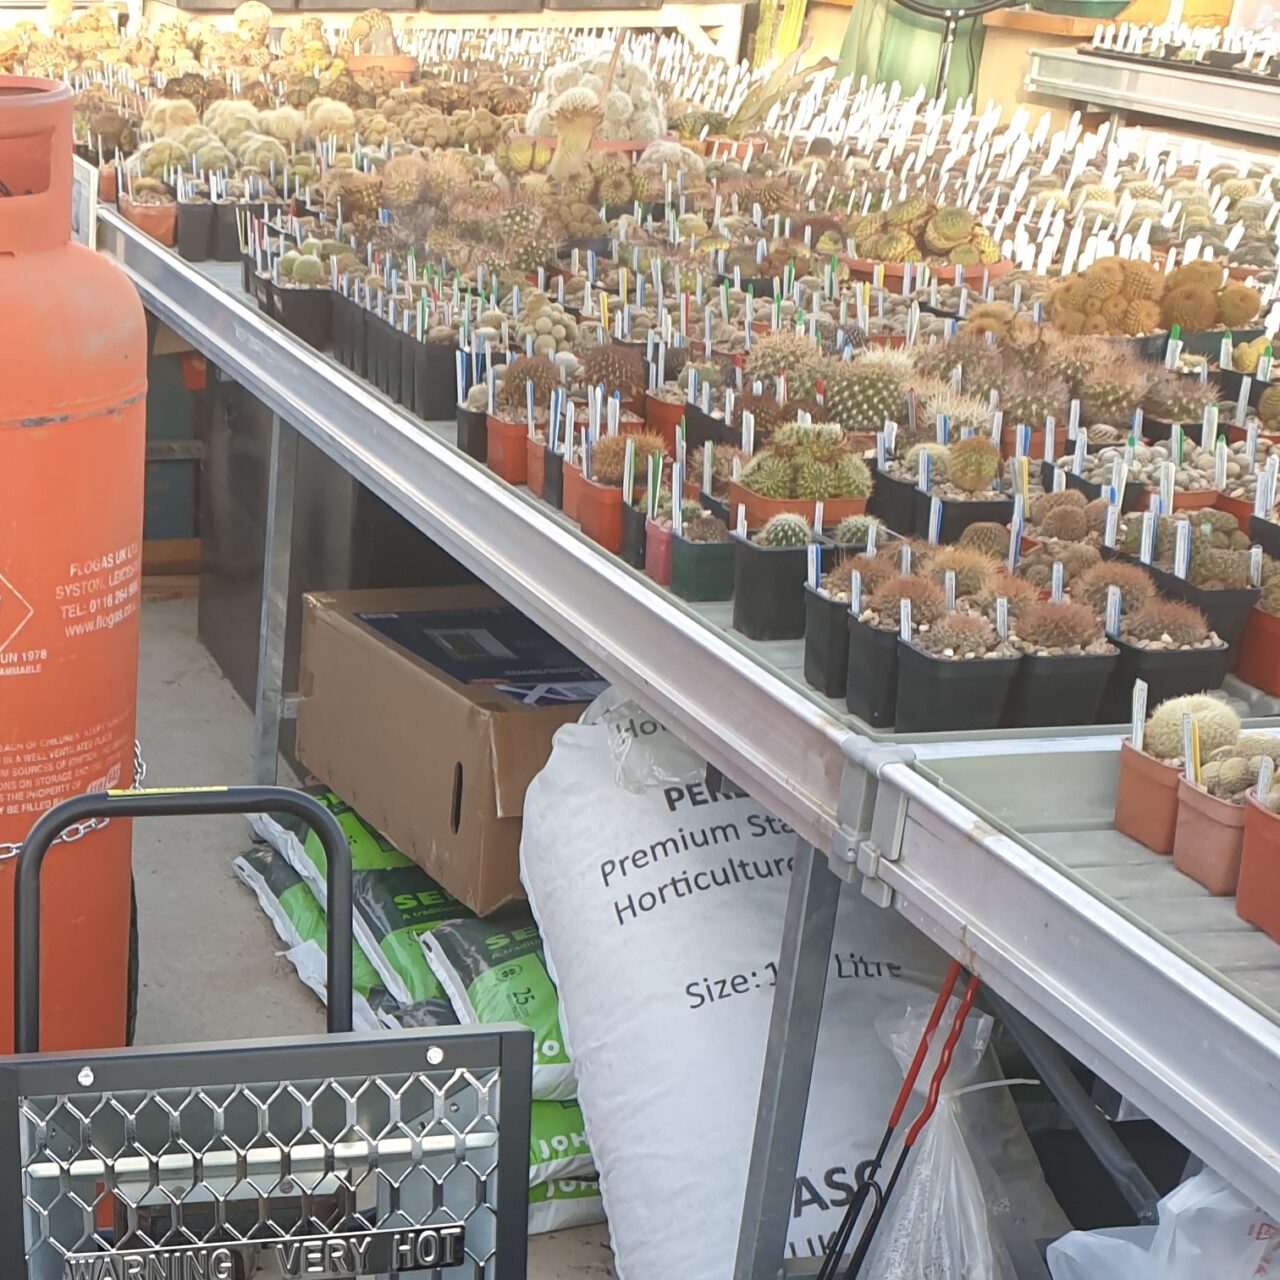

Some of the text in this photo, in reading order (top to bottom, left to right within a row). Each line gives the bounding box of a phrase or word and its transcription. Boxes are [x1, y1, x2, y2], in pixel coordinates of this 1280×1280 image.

[0, 648, 47, 664] UN 1978
[615, 718, 667, 739] Ho
[600, 822, 740, 887] Premium
[834, 953, 903, 979] Litre
[512, 987, 536, 1006] 25
[276, 1236, 373, 1280] VERY
[392, 1226, 462, 1270] HOT
